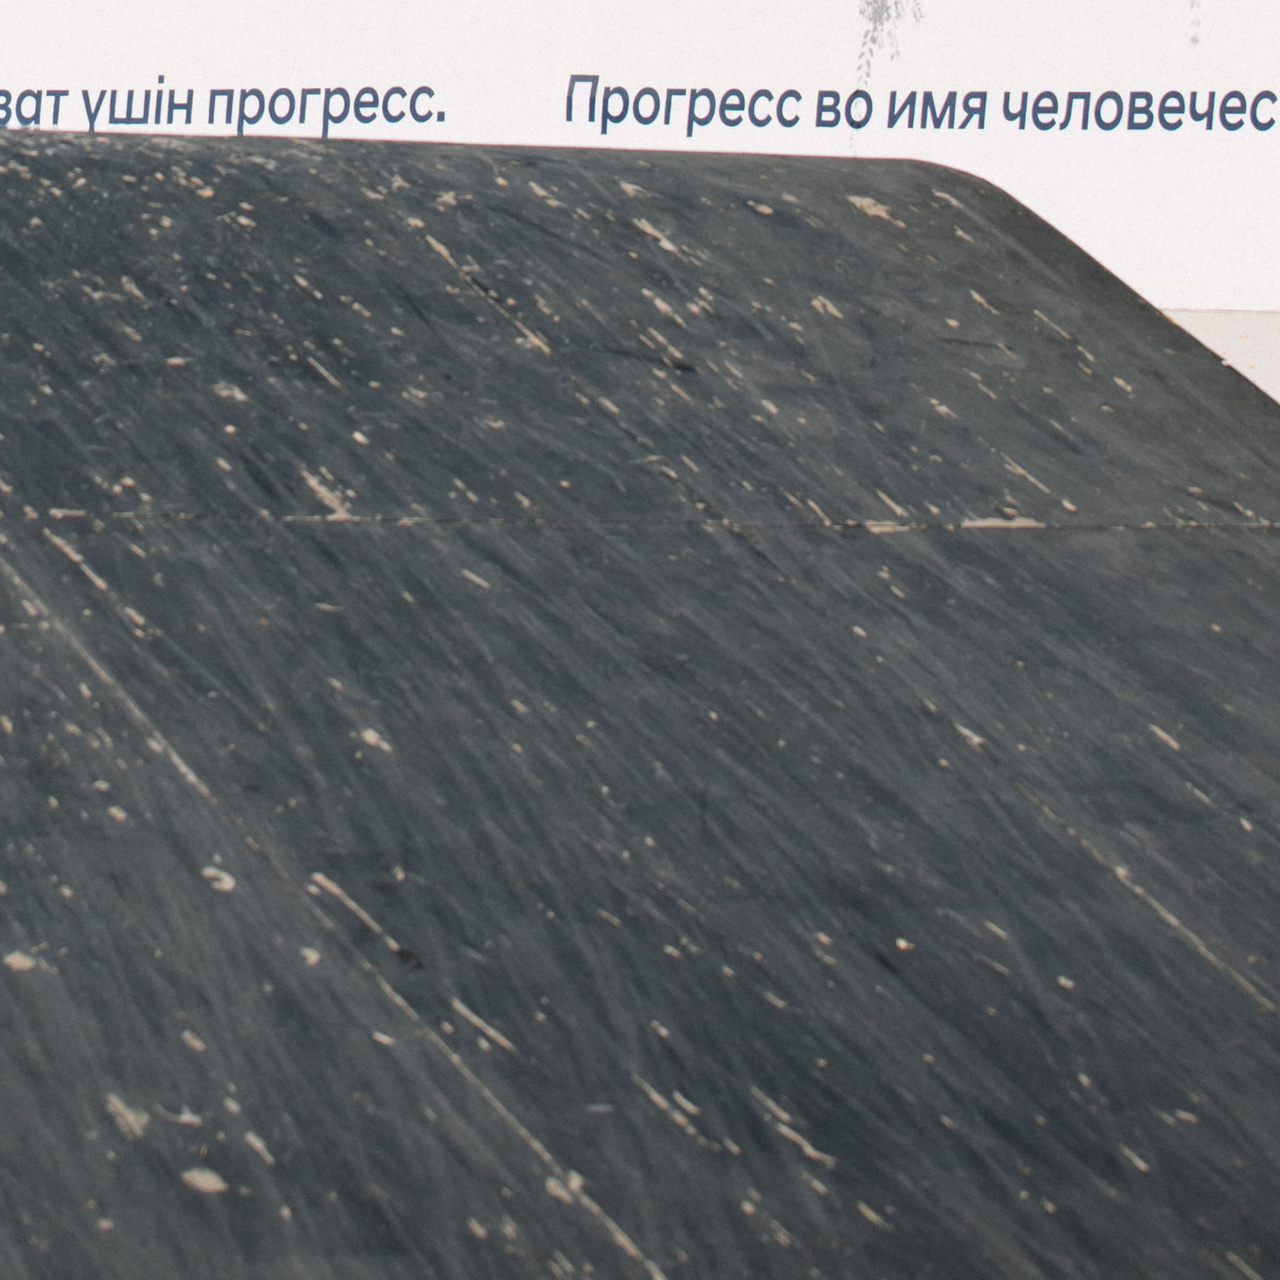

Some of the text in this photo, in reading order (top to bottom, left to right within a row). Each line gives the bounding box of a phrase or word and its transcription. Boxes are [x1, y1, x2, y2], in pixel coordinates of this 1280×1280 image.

[207, 86, 447, 139] прогресс.
[564, 74, 1280, 139] Прогресс во имя человечес
